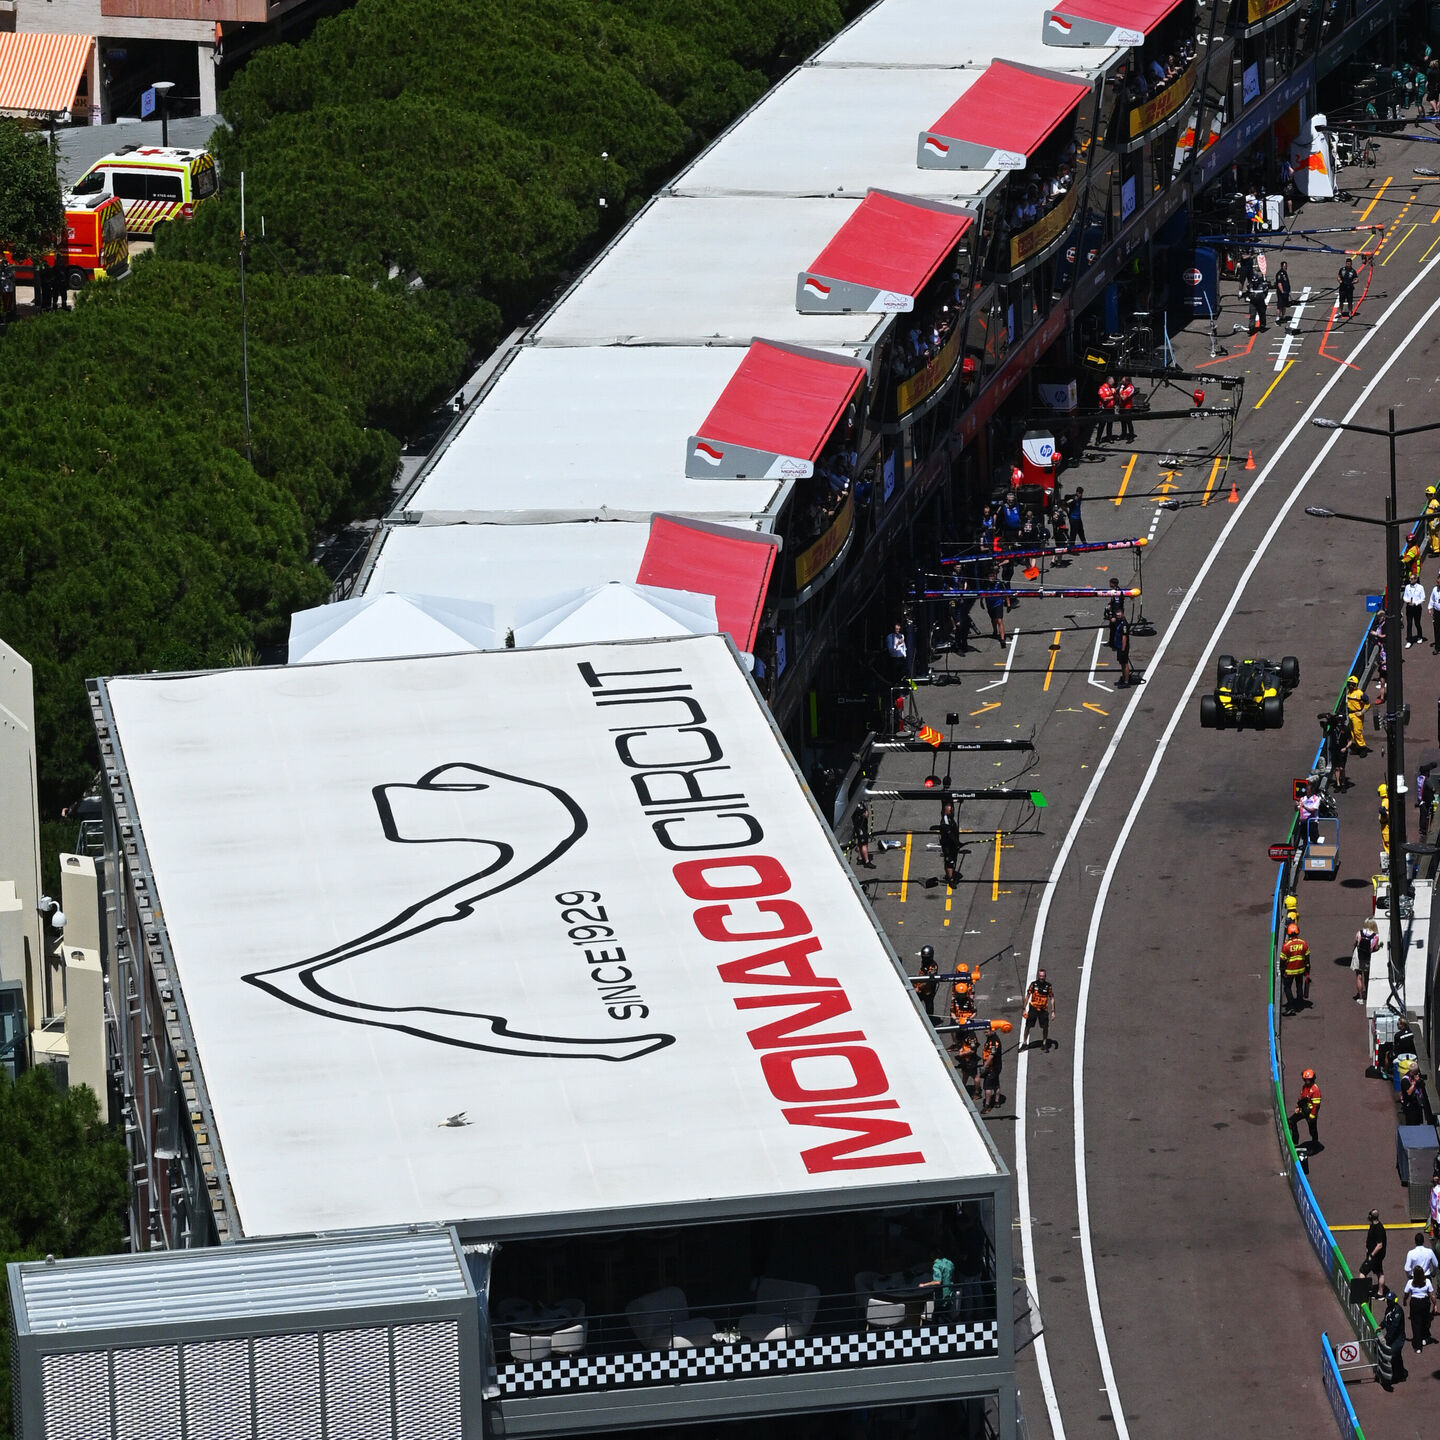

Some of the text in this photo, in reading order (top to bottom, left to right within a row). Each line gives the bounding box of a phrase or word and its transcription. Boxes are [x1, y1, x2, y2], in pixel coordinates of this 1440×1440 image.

[554, 890, 650, 1021] SINCE 1929
[577, 661, 925, 1175] MONACO CIRCUIT
